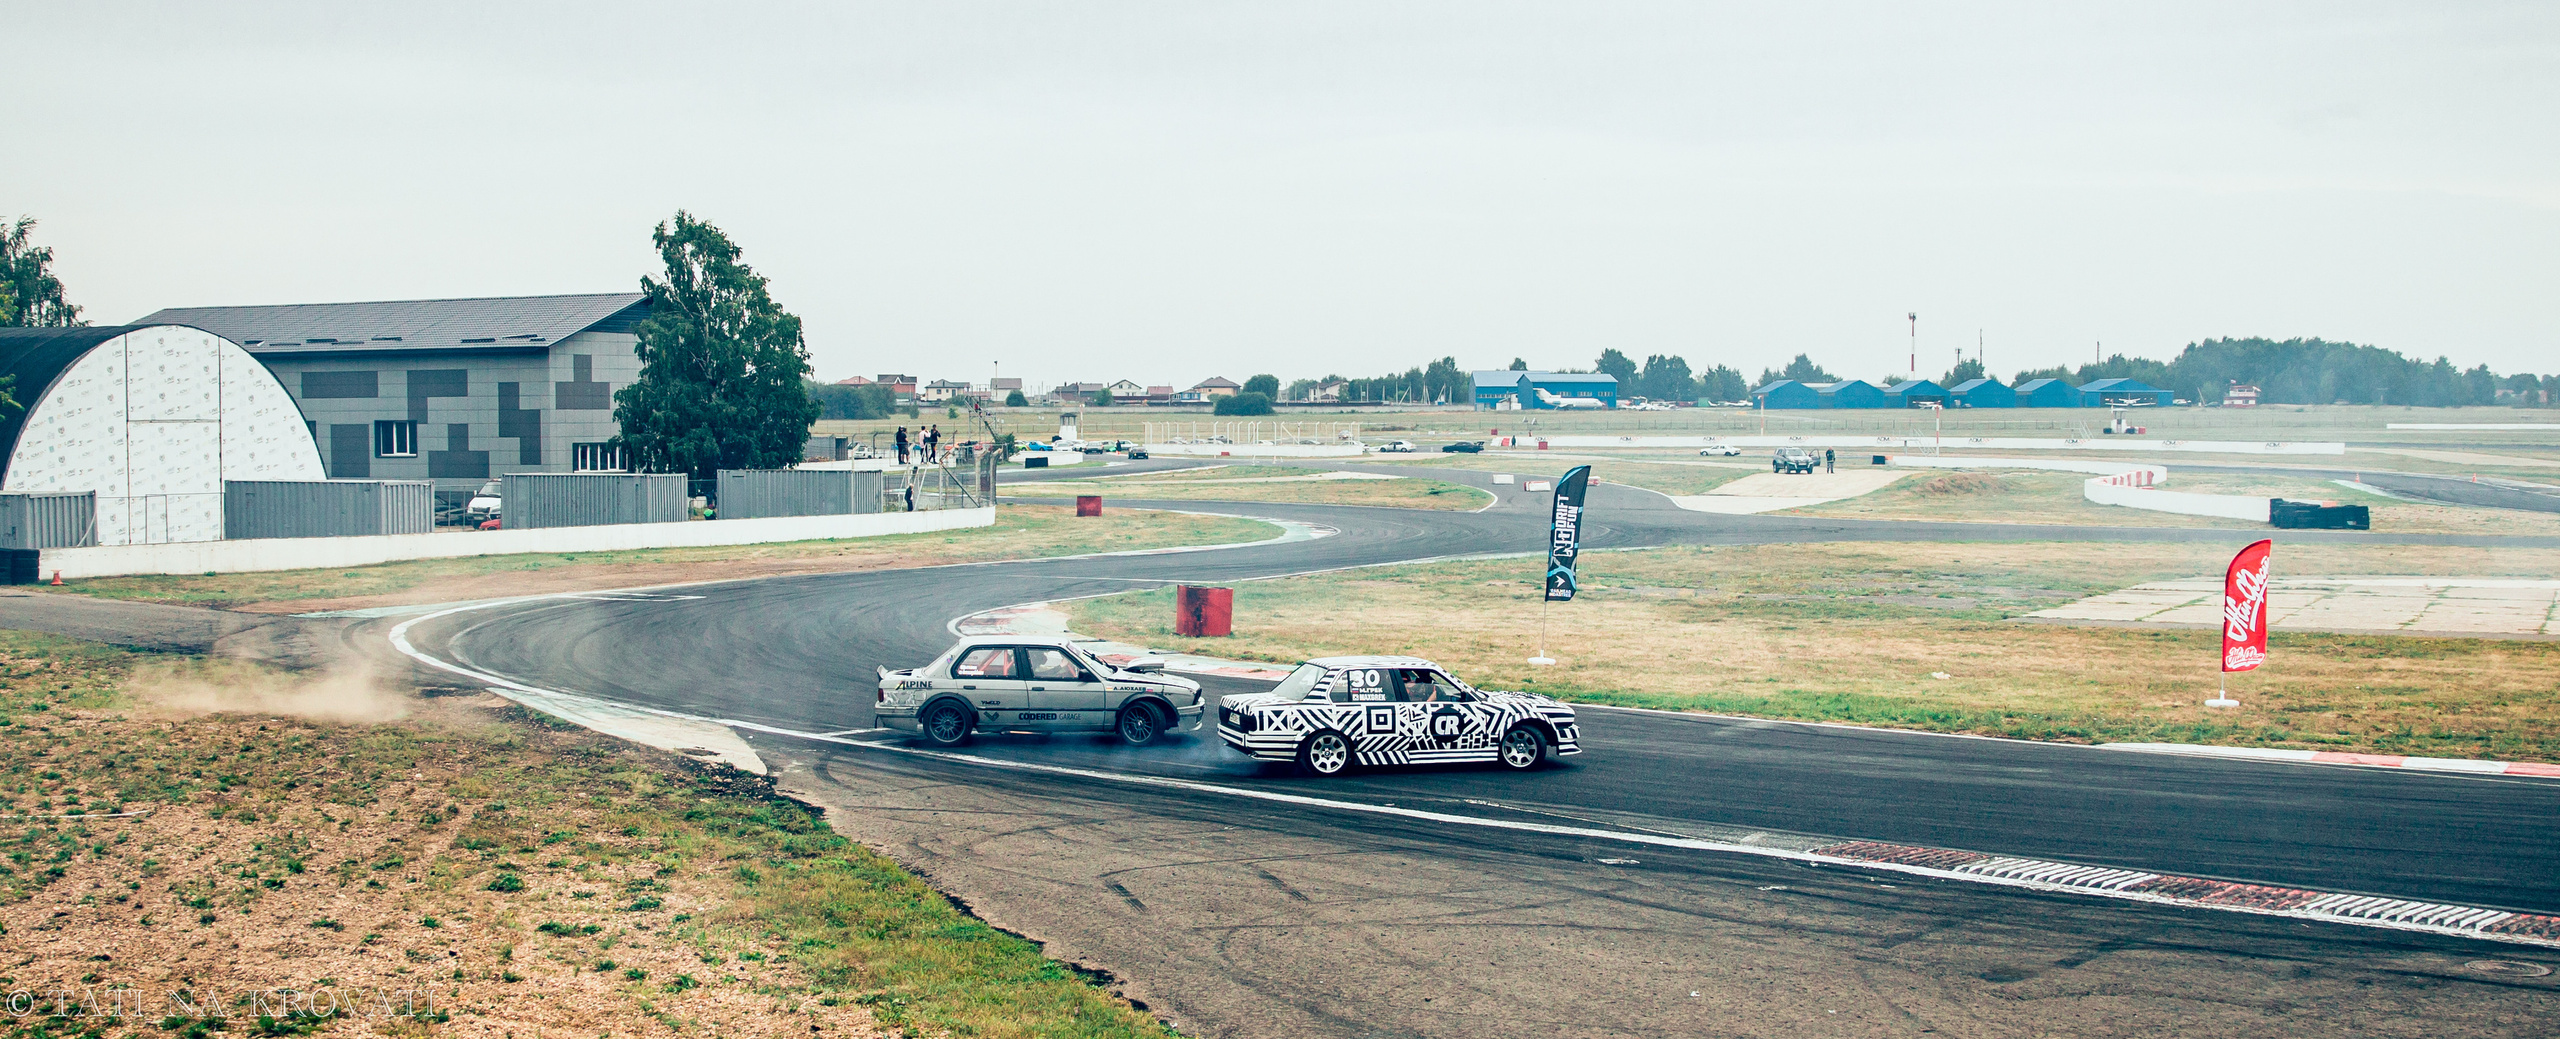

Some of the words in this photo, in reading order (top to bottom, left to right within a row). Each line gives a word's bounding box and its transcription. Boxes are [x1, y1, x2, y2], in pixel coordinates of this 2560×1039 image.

[1556, 494, 1569, 528] DRIFT
[1567, 505, 1579, 528] FUN
[896, 680, 933, 690] ALPINE
[1350, 669, 1380, 687] 30
[1018, 712, 1057, 721] CODERED
[1058, 713, 1081, 721] GARAGE
[1435, 715, 1460, 735] CR
